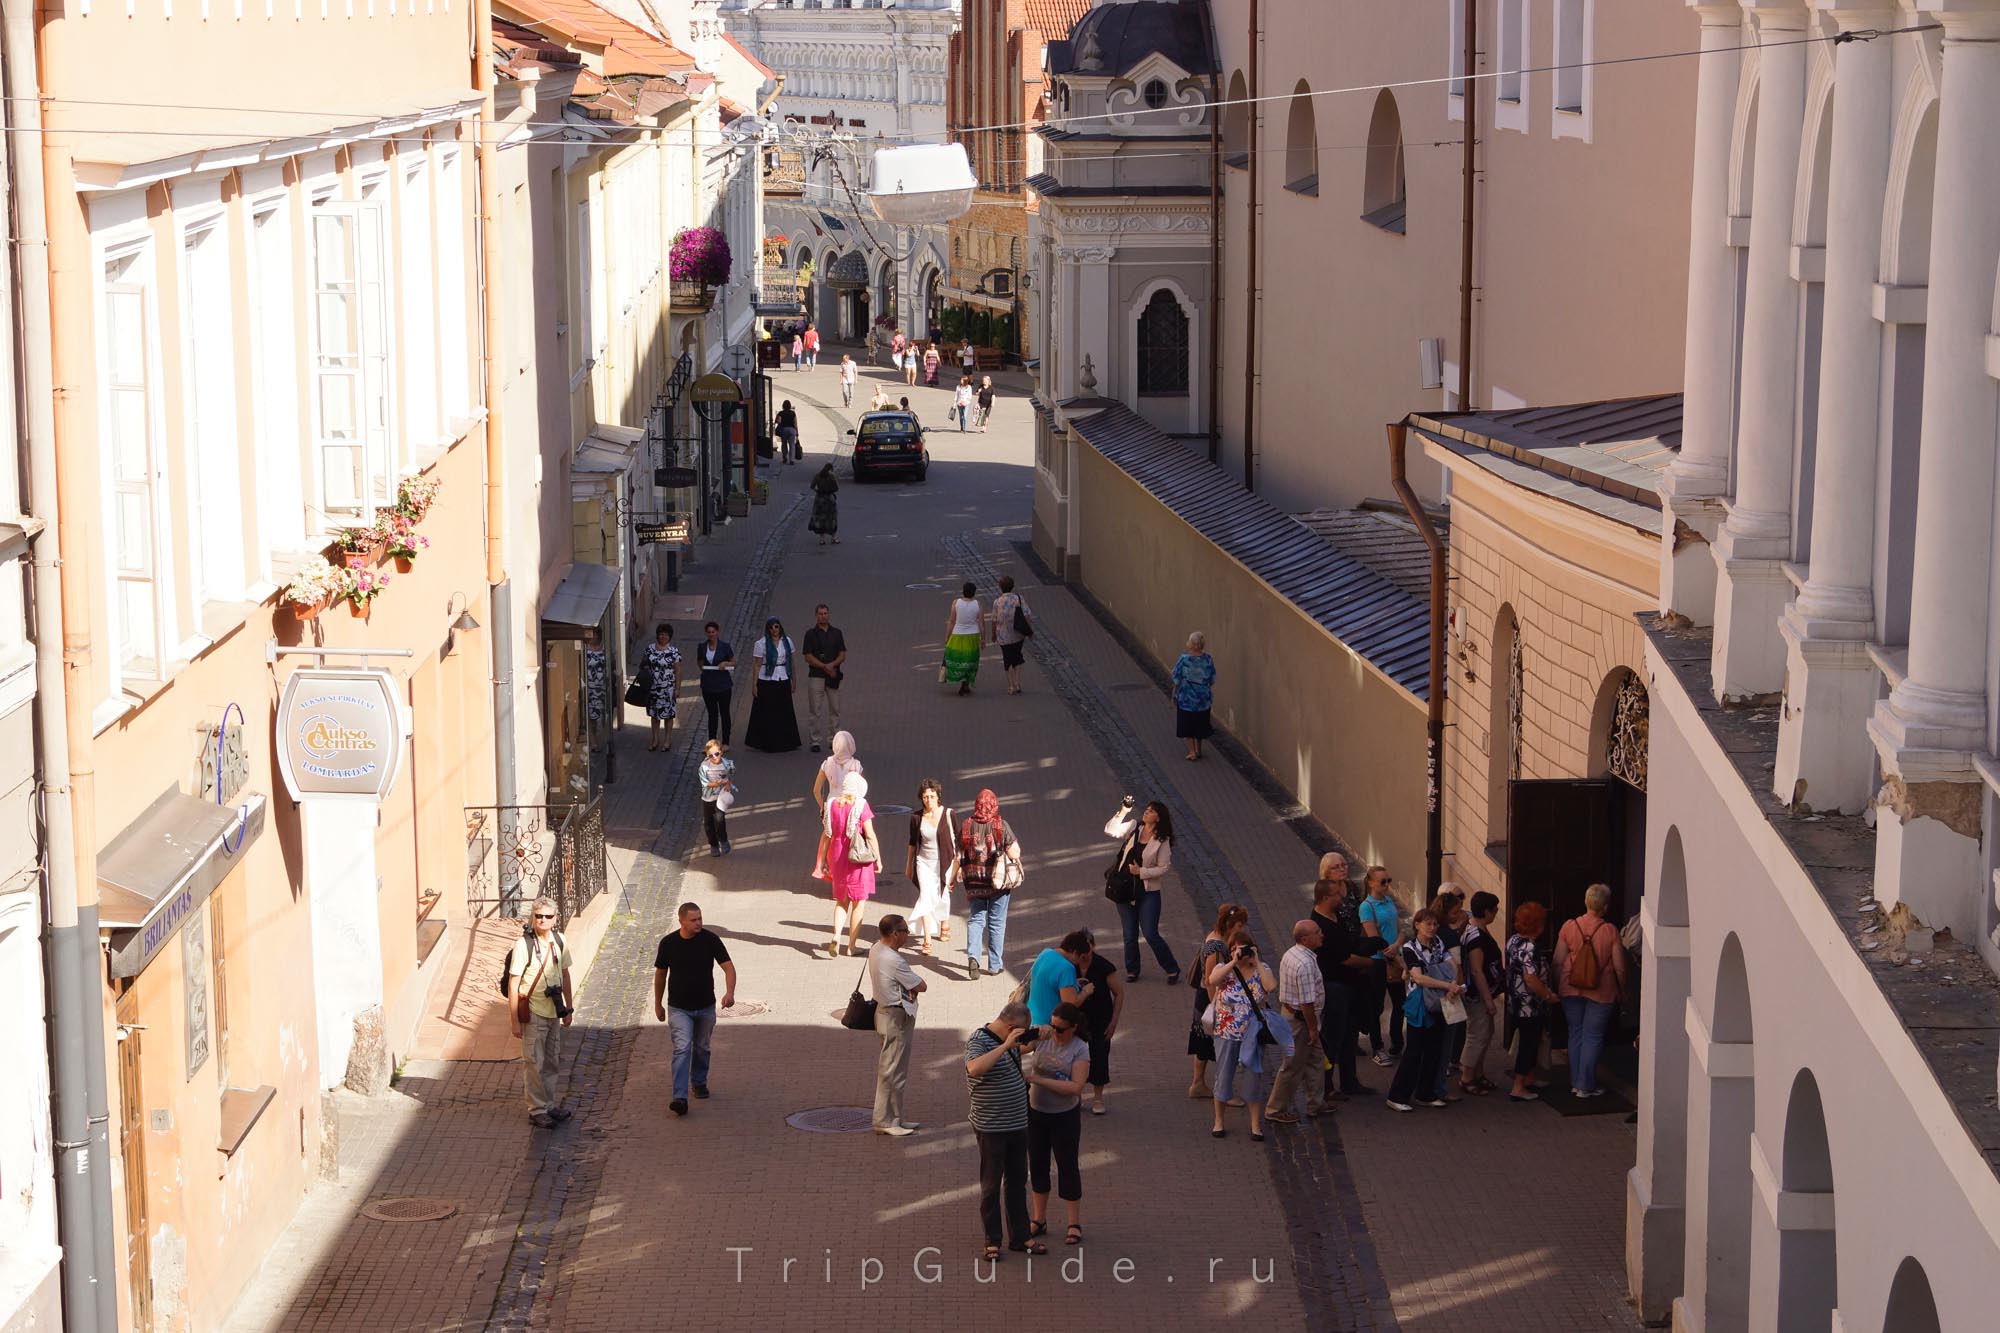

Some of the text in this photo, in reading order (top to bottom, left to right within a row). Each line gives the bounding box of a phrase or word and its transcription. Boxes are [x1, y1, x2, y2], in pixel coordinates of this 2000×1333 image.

[638, 530, 688, 538] SUVENYRAI
[307, 730, 377, 750] Centras
[315, 723, 368, 740] Aukso
[302, 760, 376, 778] LOMBARDAS
[144, 886, 192, 957] BRILIANTAS
